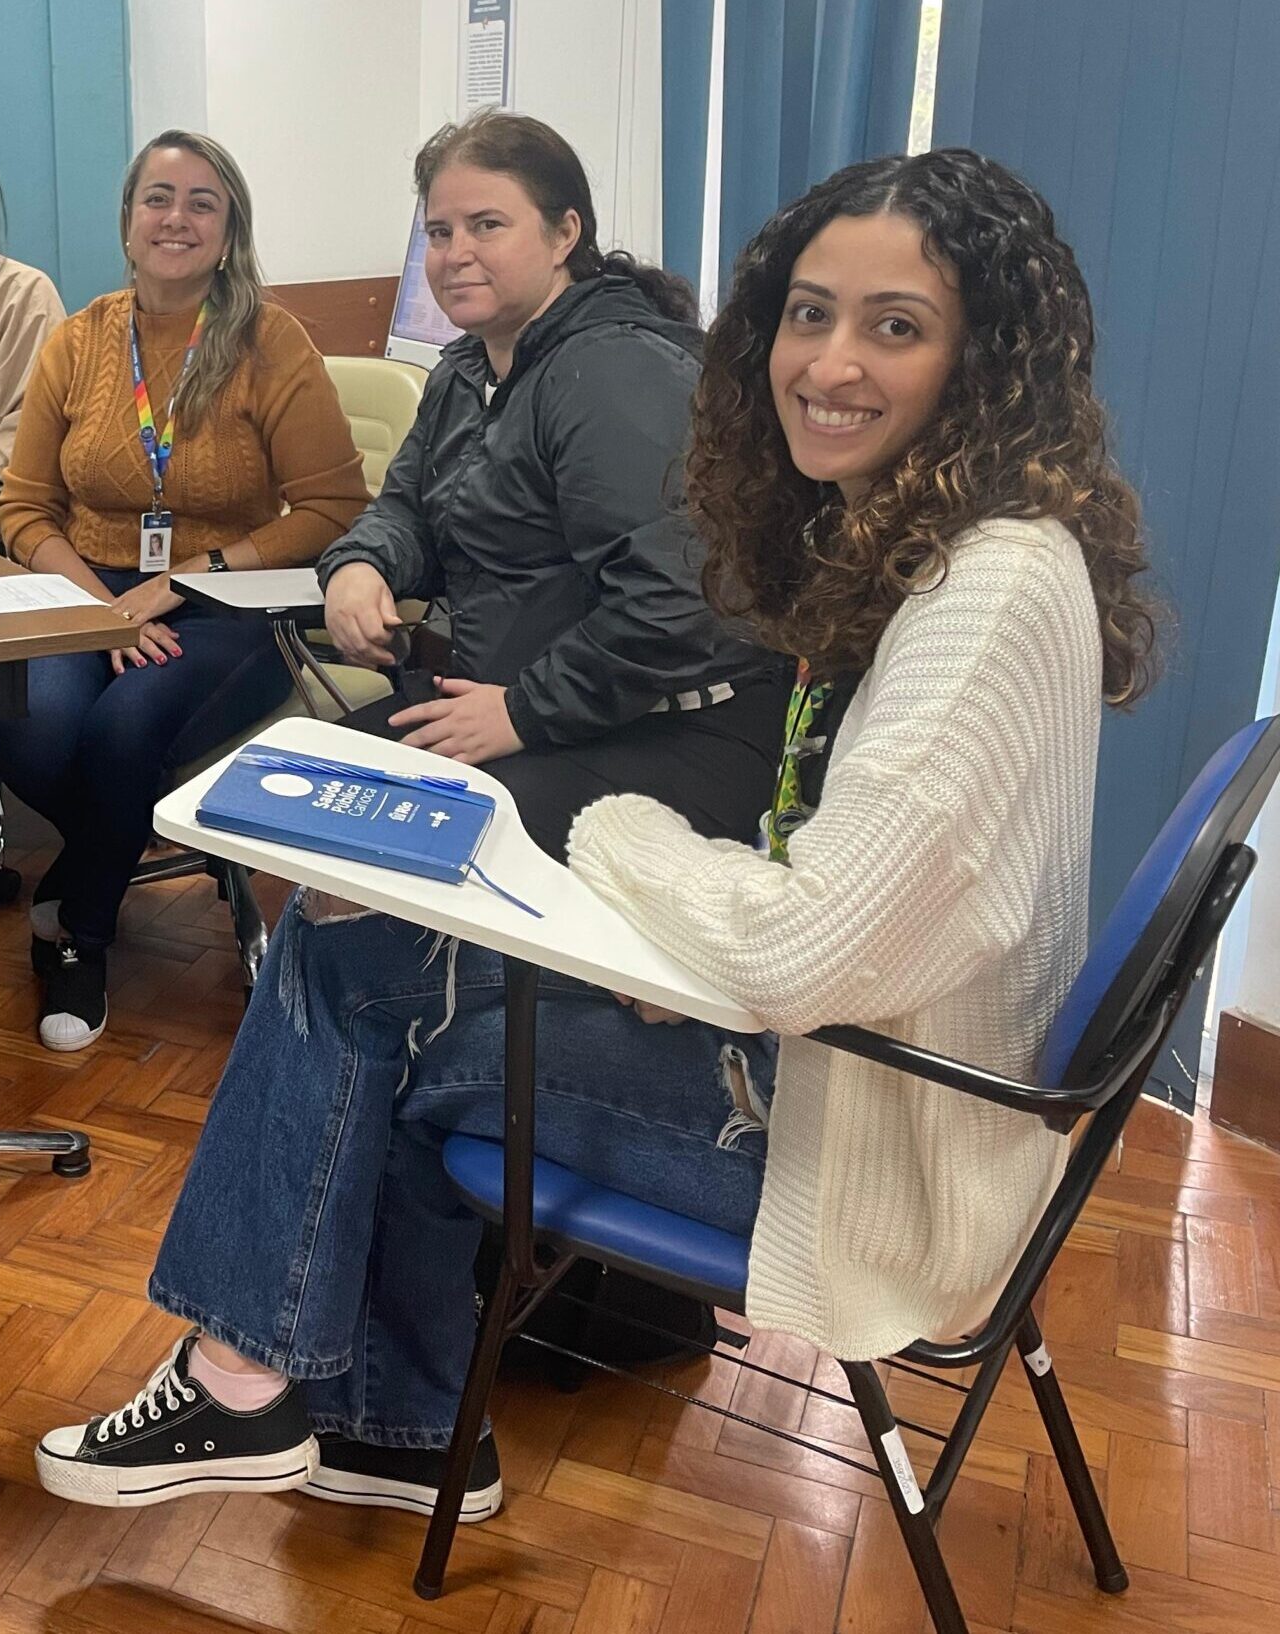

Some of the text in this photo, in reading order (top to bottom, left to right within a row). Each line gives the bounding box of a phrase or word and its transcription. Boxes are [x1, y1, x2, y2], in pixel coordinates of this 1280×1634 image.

[311, 780, 345, 809] Saúde
[330, 784, 362, 814] Pública
[347, 787, 378, 817] Carioca
